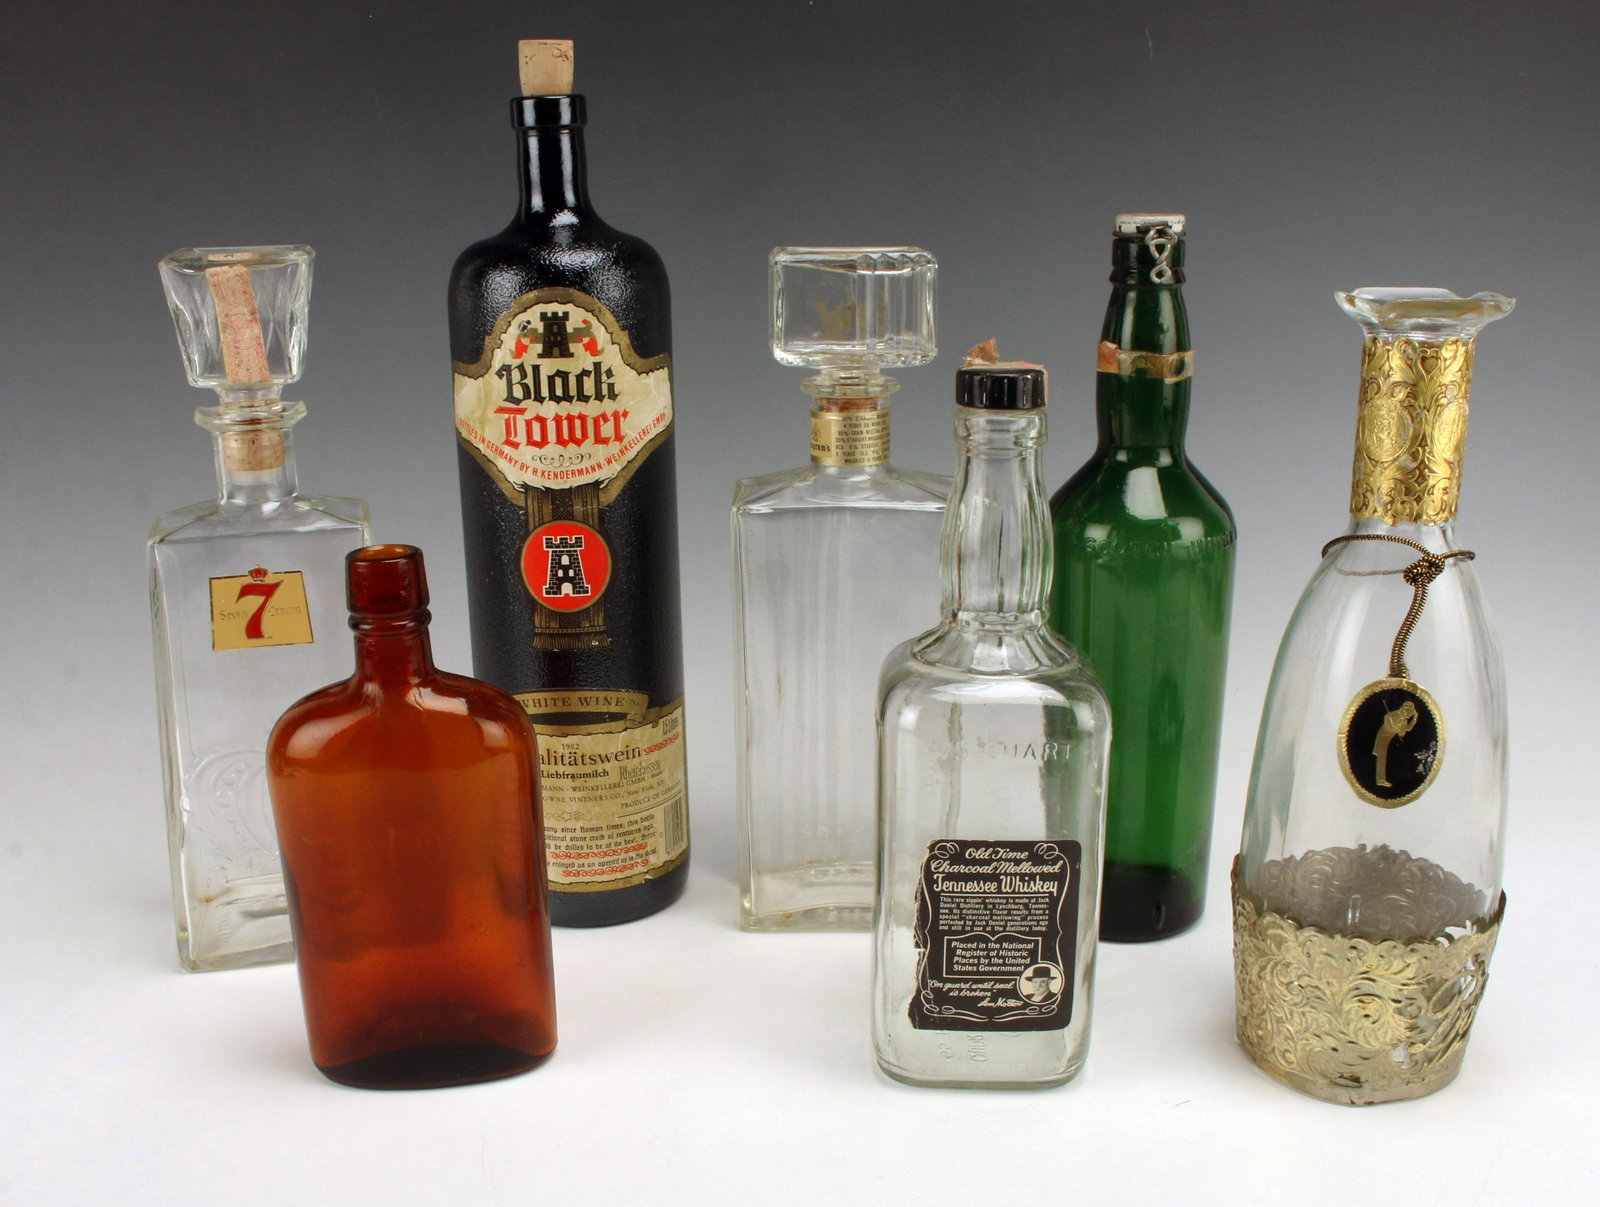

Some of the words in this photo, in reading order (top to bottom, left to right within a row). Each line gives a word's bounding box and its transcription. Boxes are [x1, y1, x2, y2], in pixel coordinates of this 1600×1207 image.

[495, 361, 621, 406] Black
[493, 405, 630, 450] Tower
[479, 434, 487, 444] IN
[486, 440, 519, 467] GERMANY
[519, 462, 530, 473] BY
[605, 424, 653, 466] WEINKELLEREI
[235, 579, 284, 639] 7
[521, 697, 571, 709] WHITE
[578, 696, 624, 708] WINE
[561, 743, 580, 751] 1982
[539, 744, 641, 768] alitätswein
[541, 768, 609, 780] Liebfraumilch
[965, 847, 992, 860] Old
[992, 847, 1029, 860] Time
[930, 859, 995, 874] Charcoal
[995, 860, 1063, 874] Mellowed
[933, 873, 998, 892] Tennessee
[1000, 875, 1058, 897] Whiskey
[952, 941, 977, 949] Placed
[979, 941, 986, 949] in
[956, 949, 987, 957] Register
[989, 949, 998, 957] of
[999, 949, 1029, 957] Historic
[980, 957, 989, 966] by
[1005, 957, 1031, 965] United
